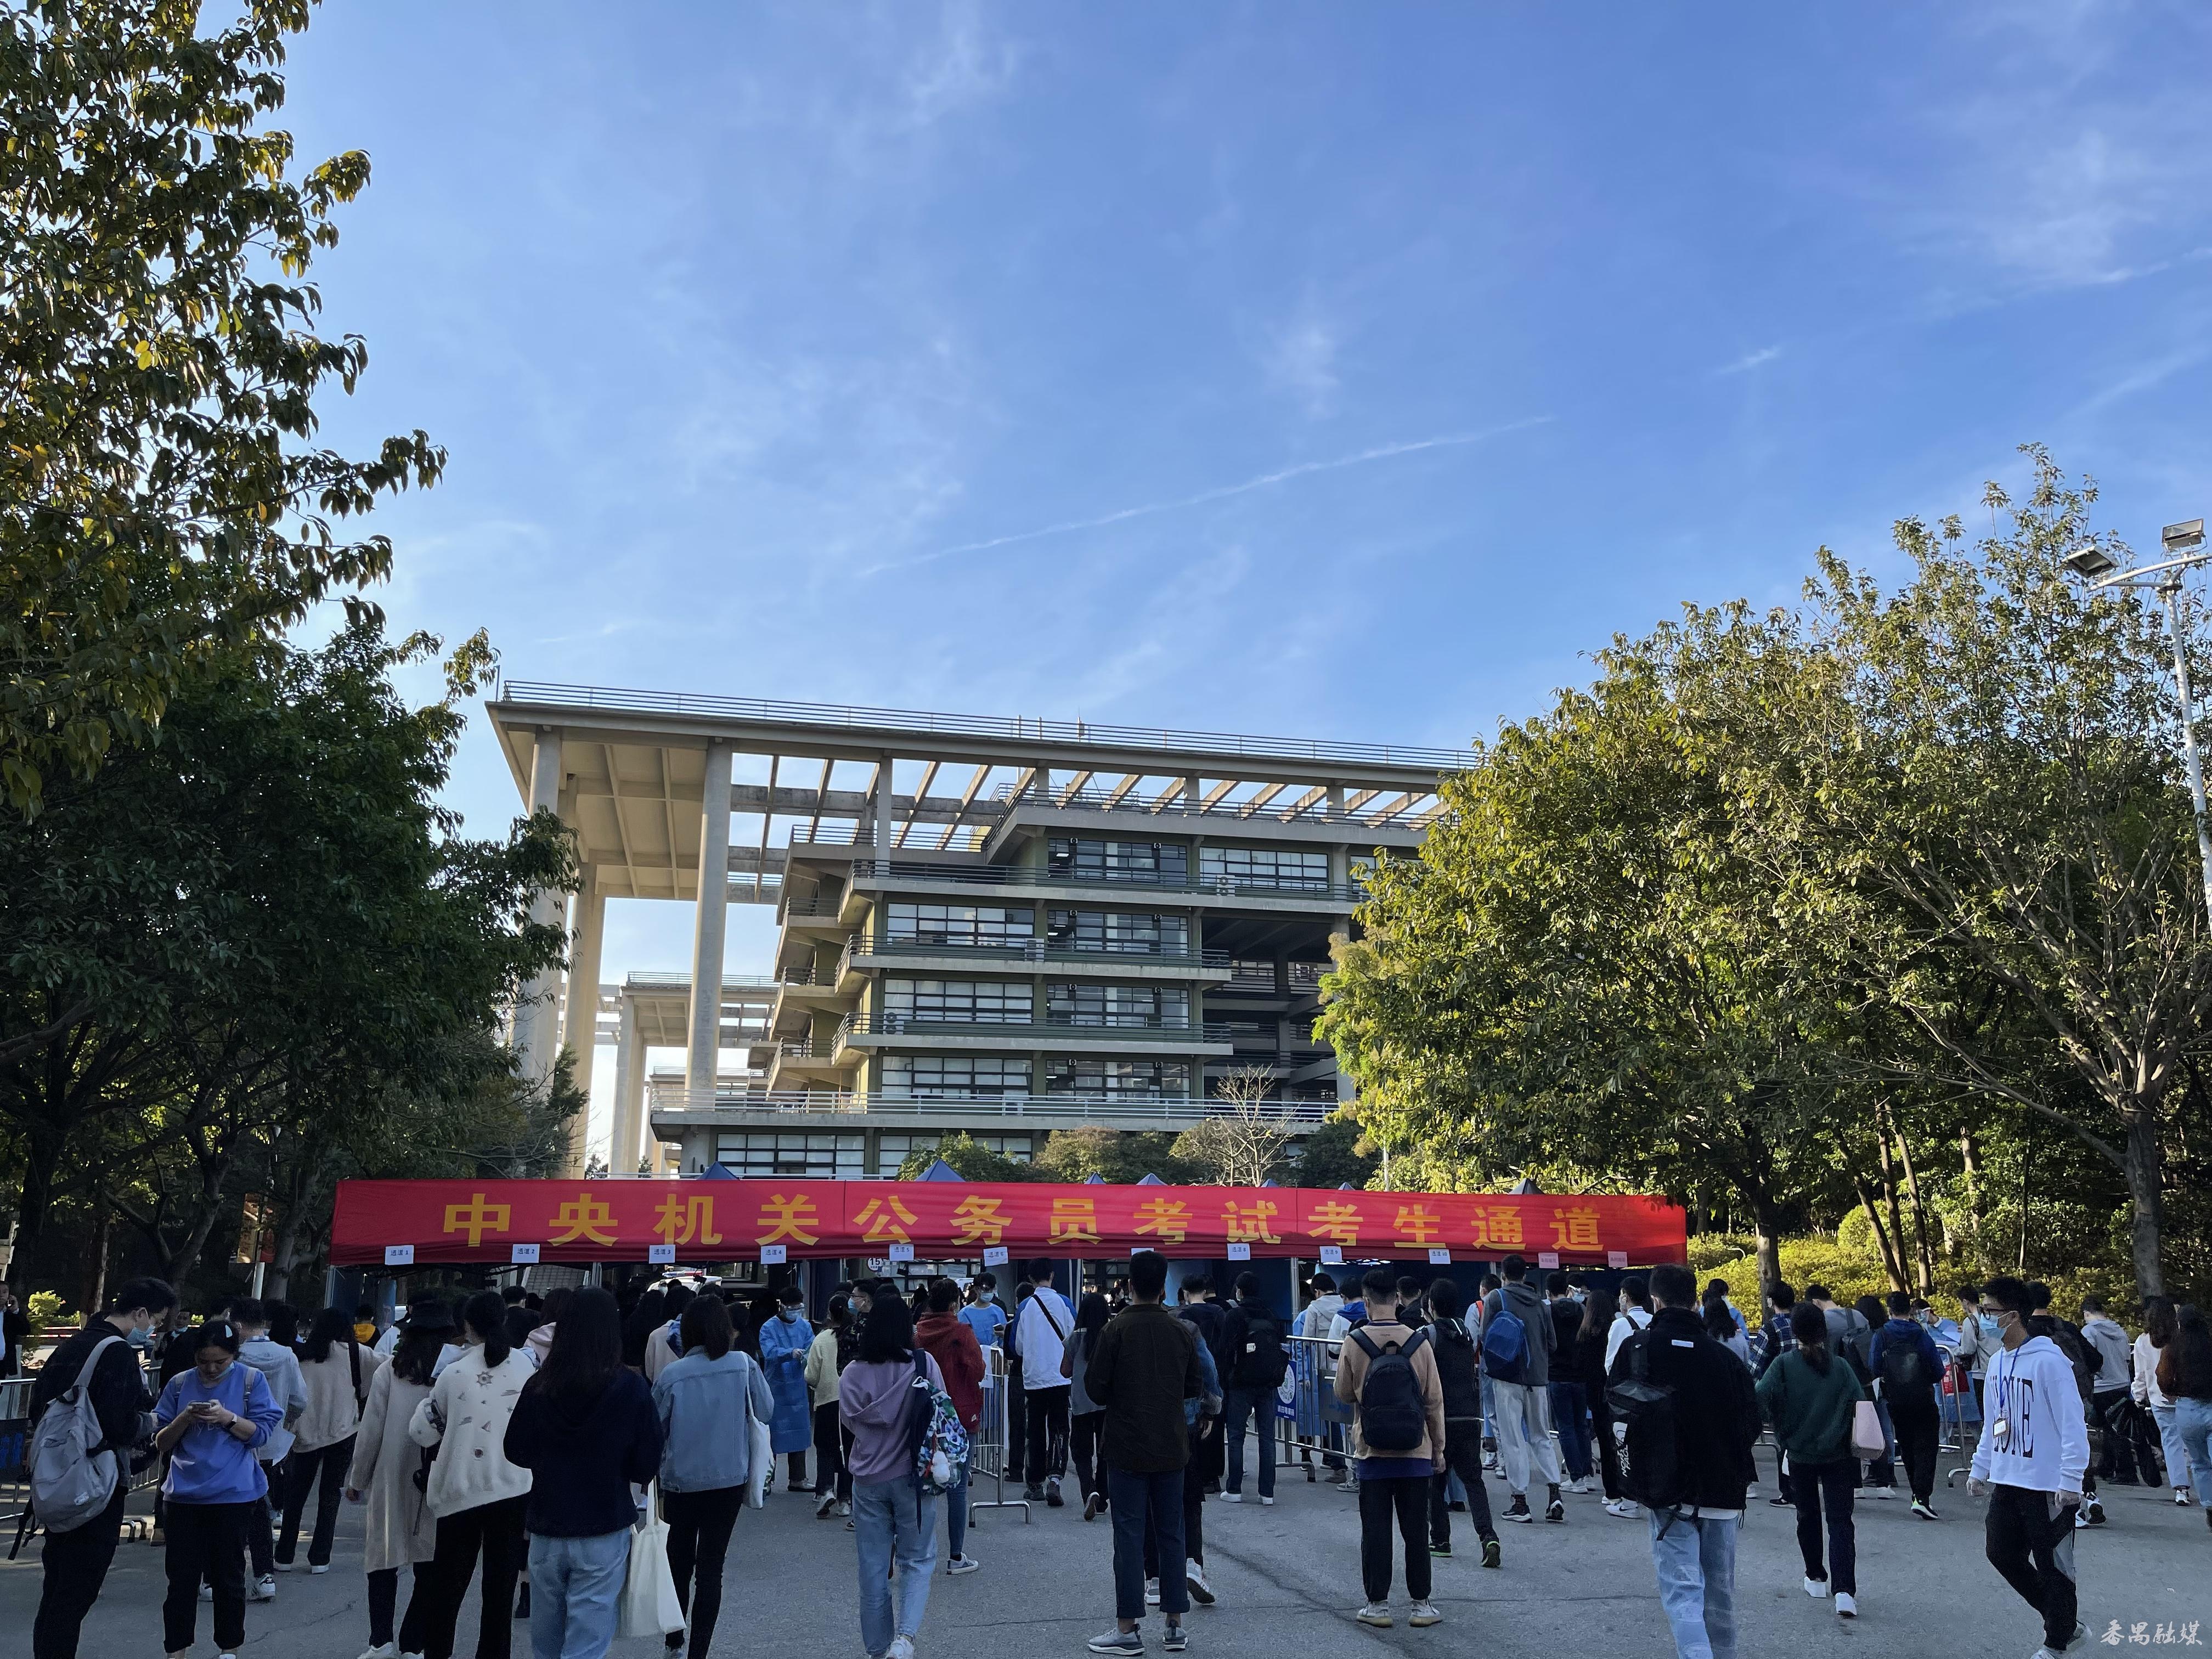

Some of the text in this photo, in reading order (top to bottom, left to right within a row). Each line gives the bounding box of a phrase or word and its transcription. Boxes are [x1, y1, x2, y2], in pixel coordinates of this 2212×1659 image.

[443, 1193, 1604, 1251] 中央机关公务员考试考生通道
